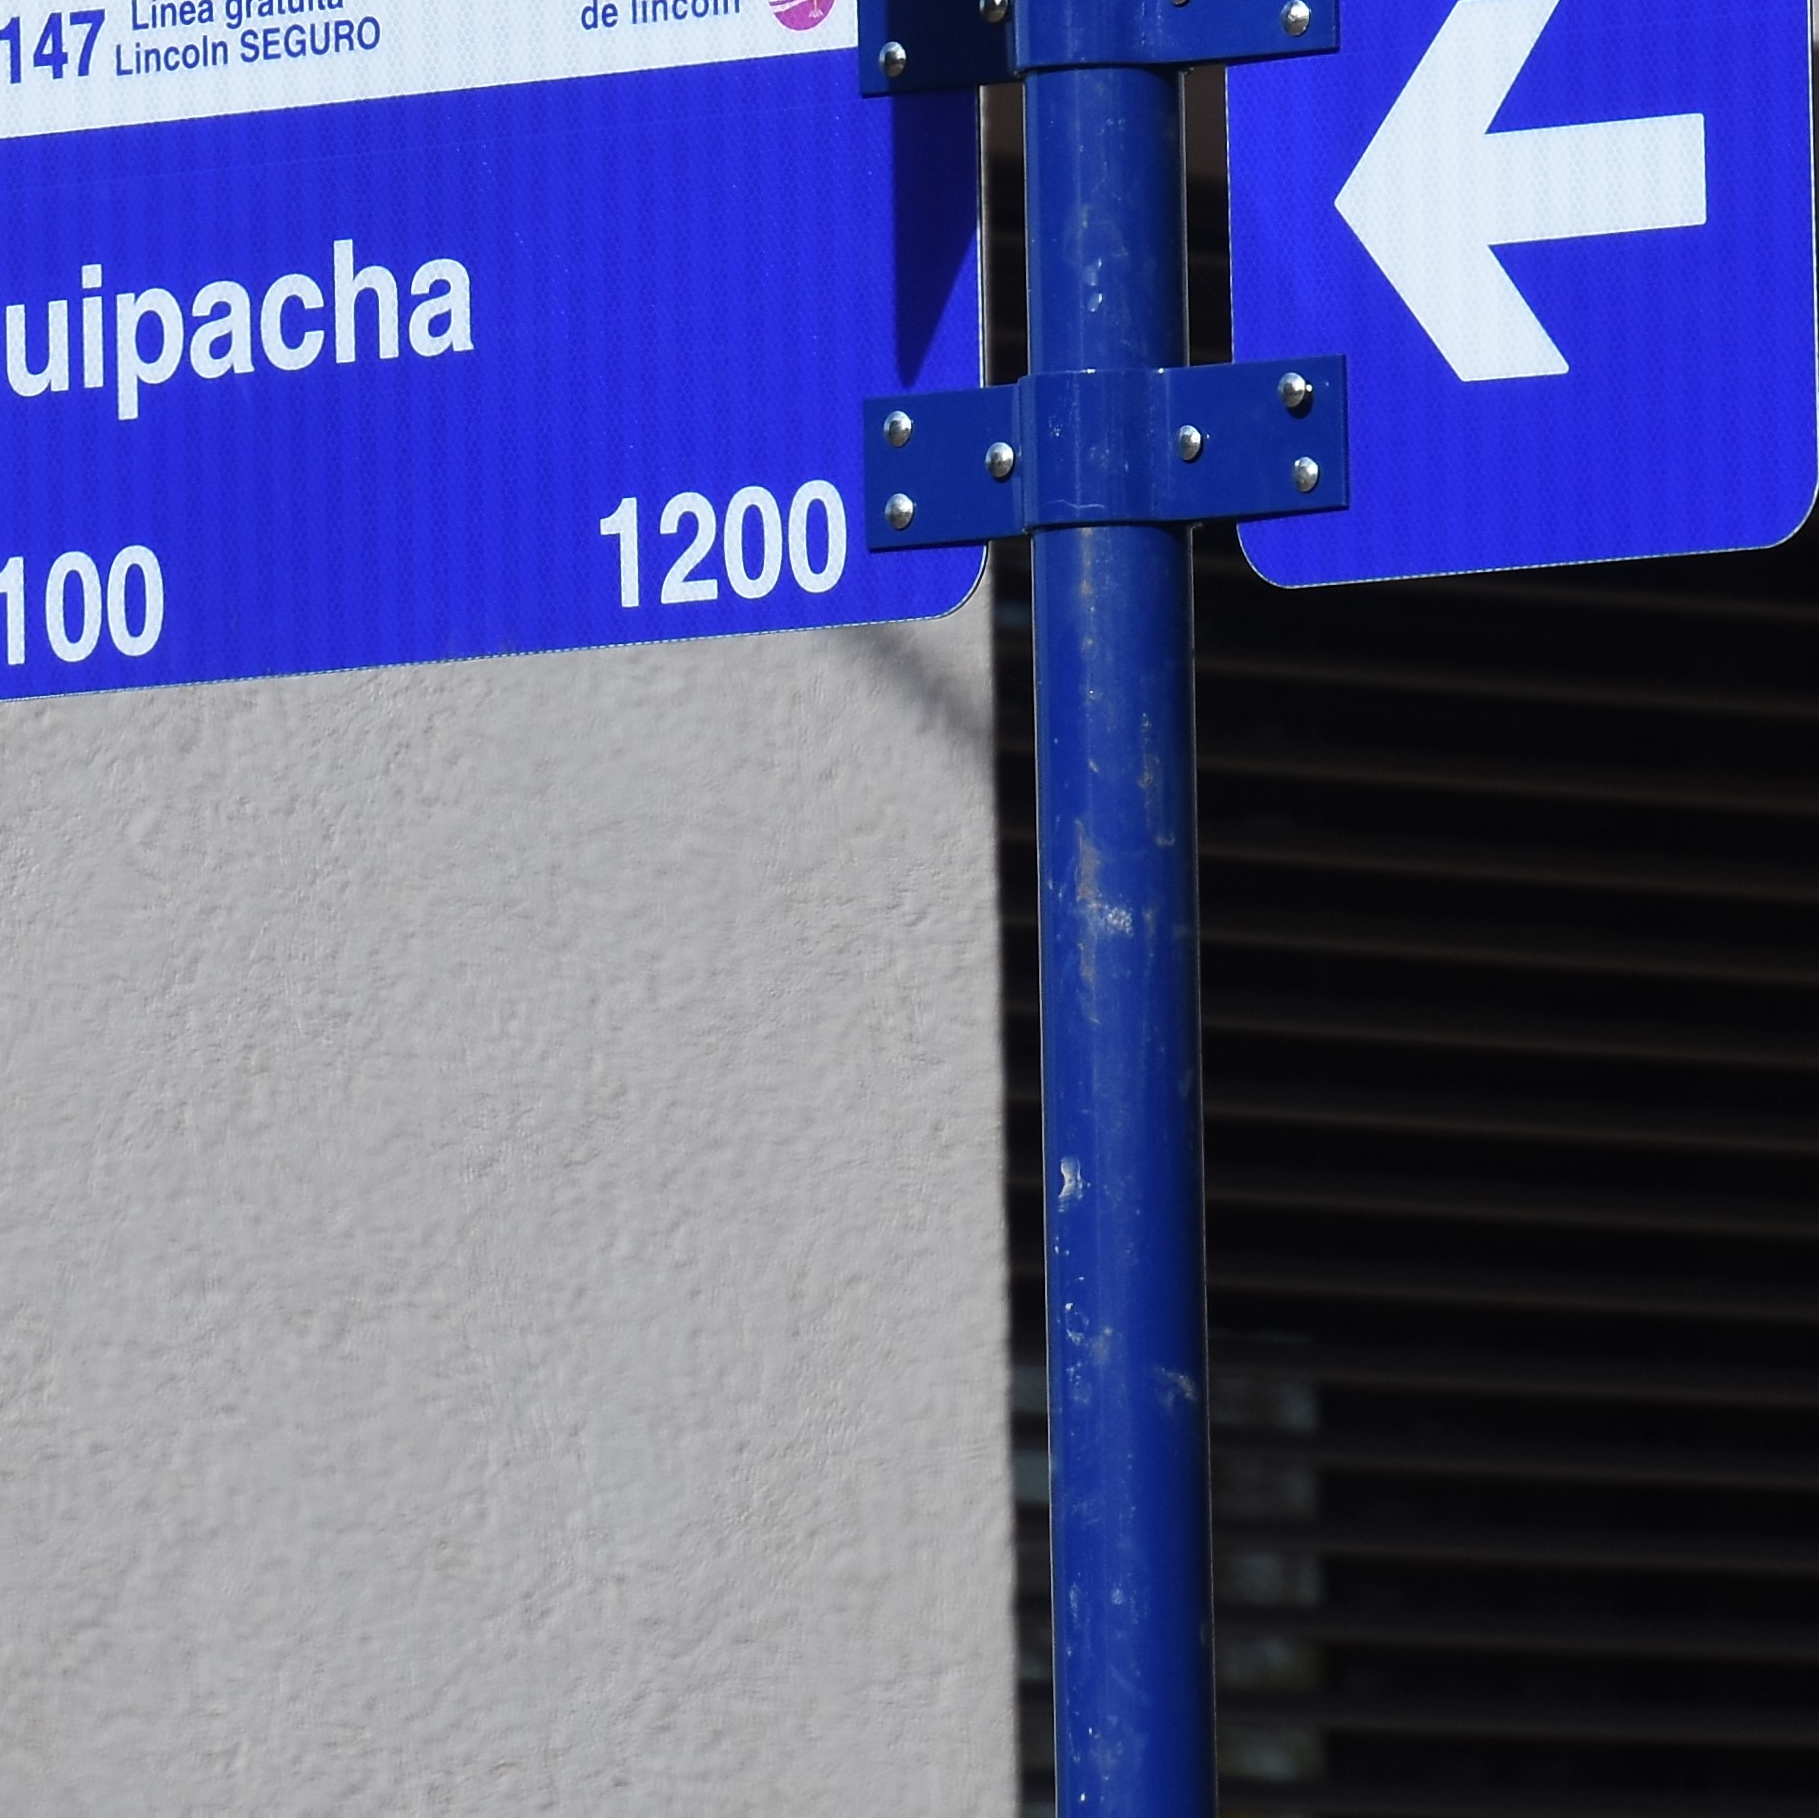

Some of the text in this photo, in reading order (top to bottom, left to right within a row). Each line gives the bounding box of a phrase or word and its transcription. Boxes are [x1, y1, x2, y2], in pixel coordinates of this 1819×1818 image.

[116, 16, 380, 76] Lincoln SEGURO
[600, 480, 847, 607] 1200
